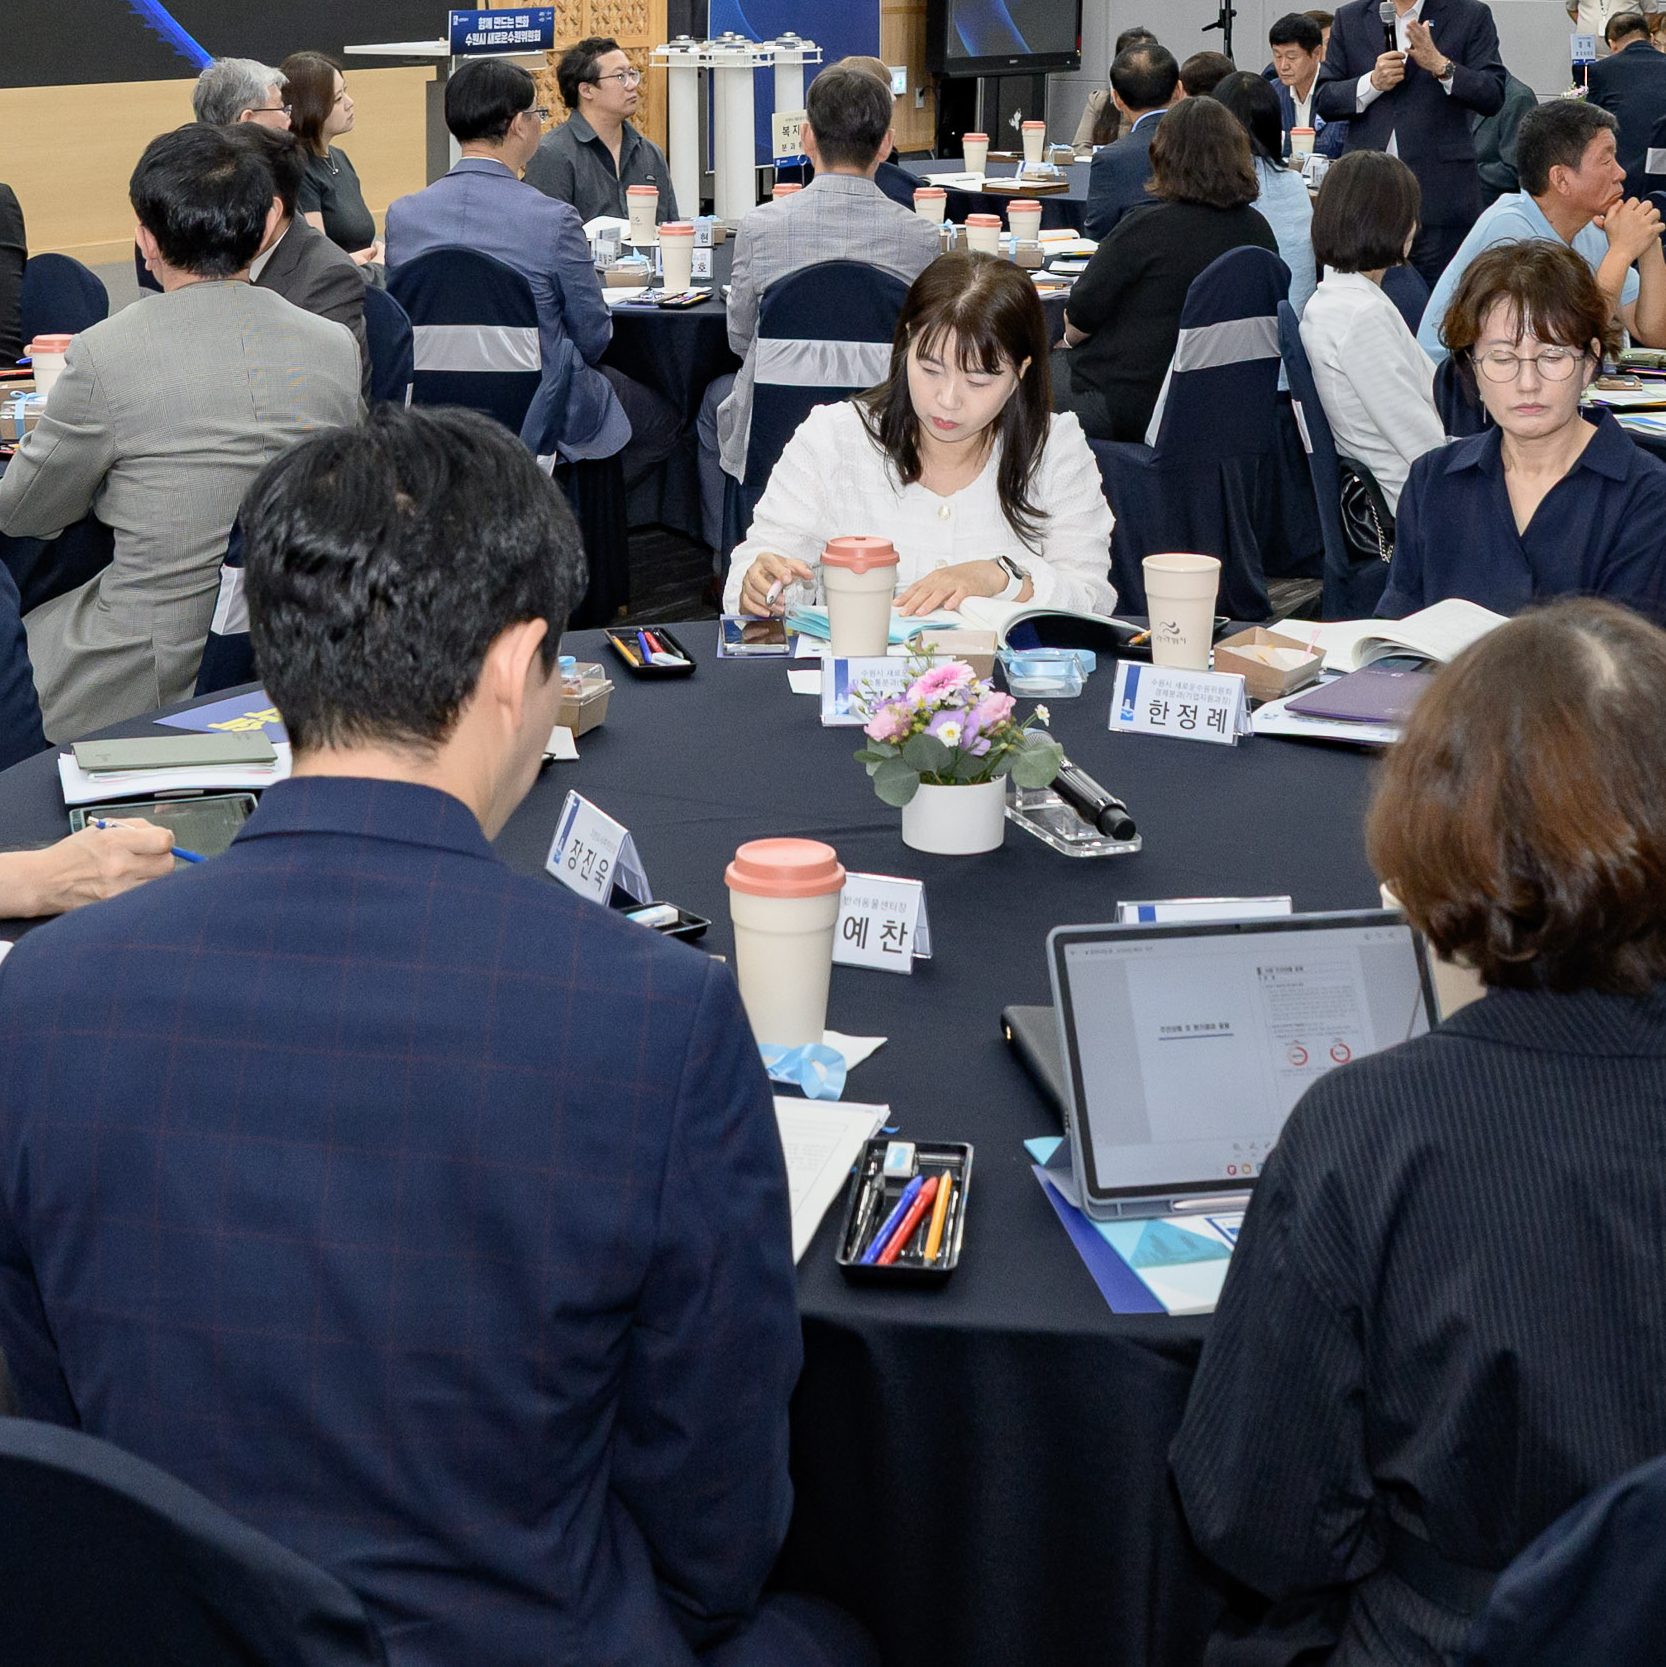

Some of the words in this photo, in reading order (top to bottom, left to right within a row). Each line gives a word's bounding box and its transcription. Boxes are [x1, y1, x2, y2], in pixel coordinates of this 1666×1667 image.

[1148, 699, 1228, 735] 한정례
[567, 838, 609, 892] 장진욱
[843, 916, 909, 954] 예찬
